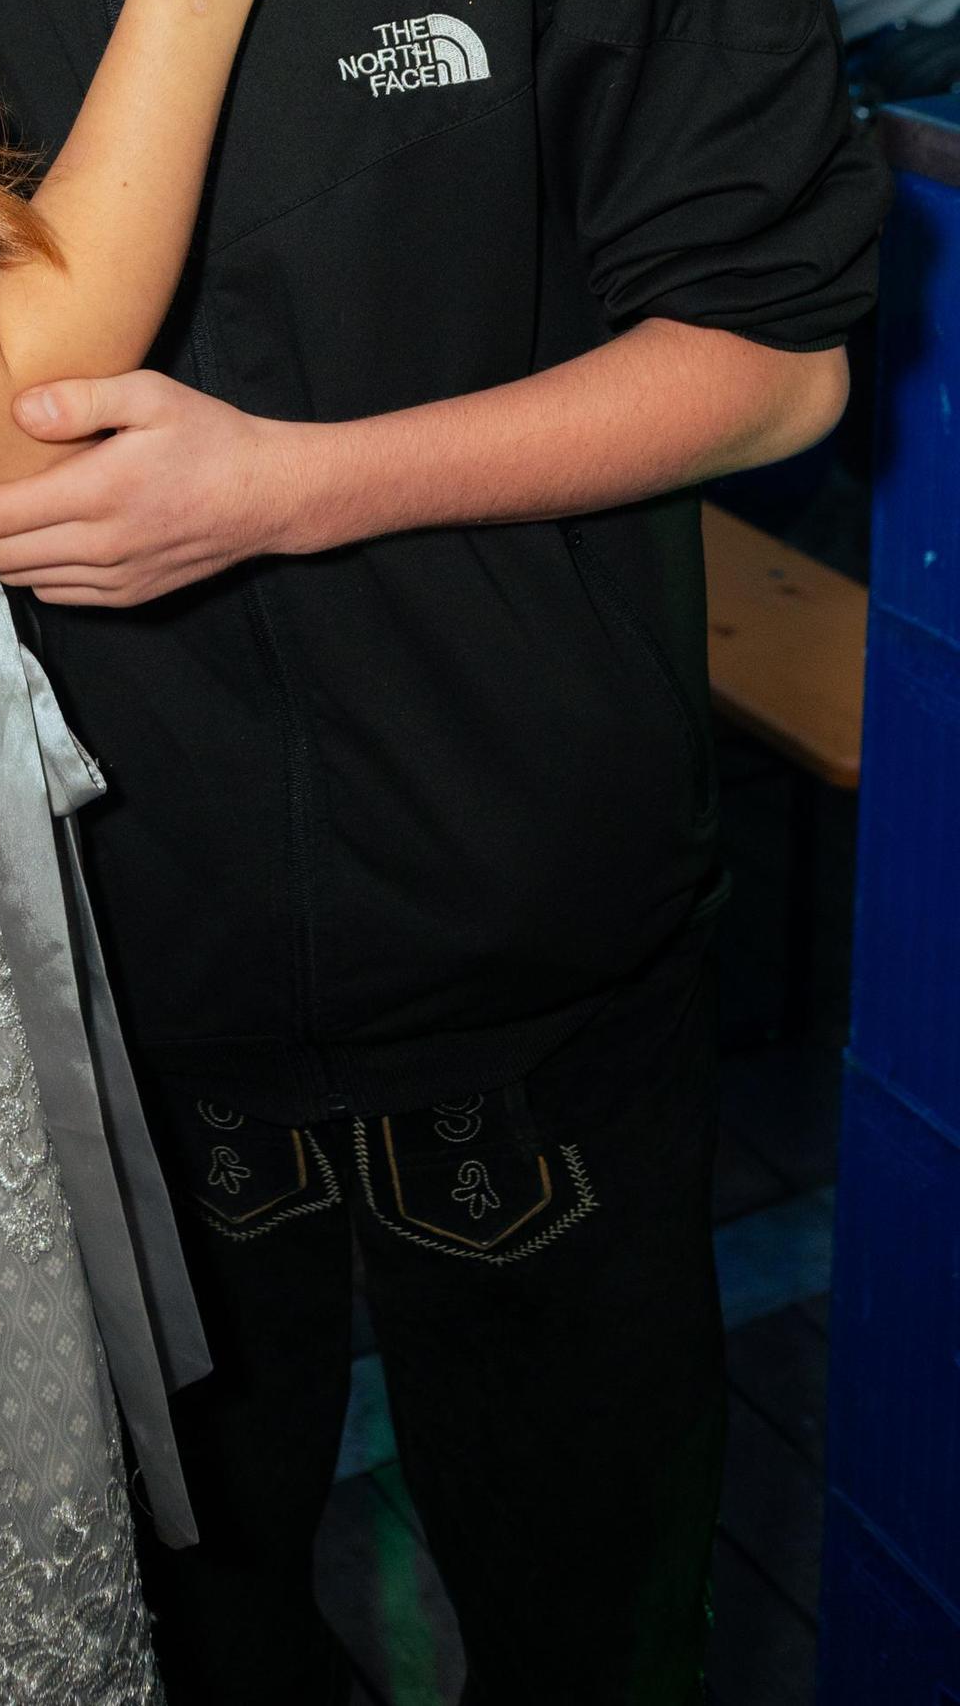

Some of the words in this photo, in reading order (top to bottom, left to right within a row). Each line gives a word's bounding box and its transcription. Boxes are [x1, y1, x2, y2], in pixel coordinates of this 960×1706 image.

[373, 17, 430, 46] THE
[338, 39, 434, 81] NORTH
[369, 64, 439, 98] FACE
